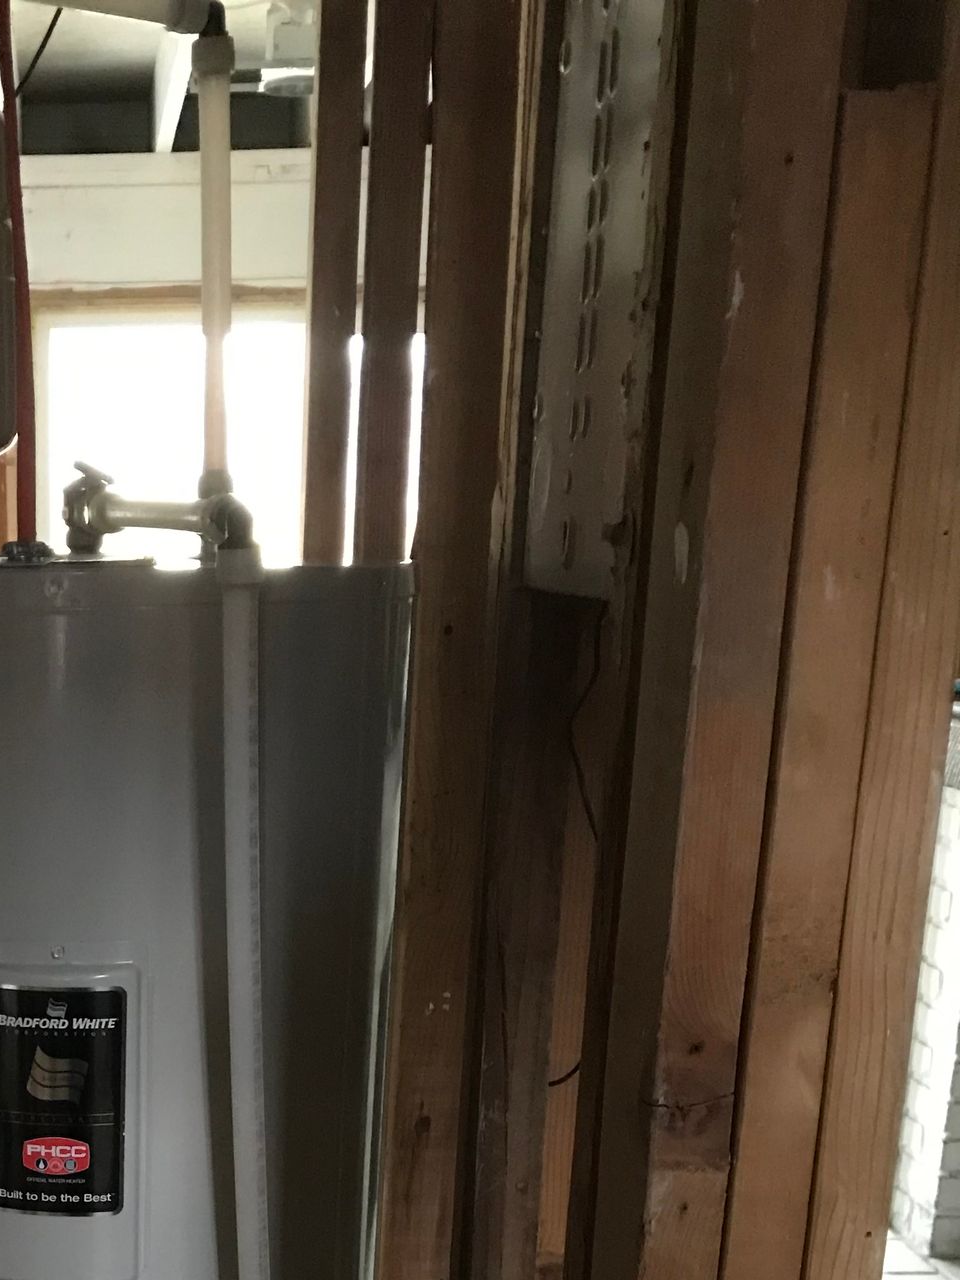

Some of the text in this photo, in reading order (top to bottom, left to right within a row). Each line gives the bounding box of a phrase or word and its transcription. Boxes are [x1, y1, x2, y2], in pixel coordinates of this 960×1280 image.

[72, 1017, 117, 1030] WHITE
[26, 1144, 87, 1158] PHCC
[0, 1188, 112, 1203] Built to be the Best
